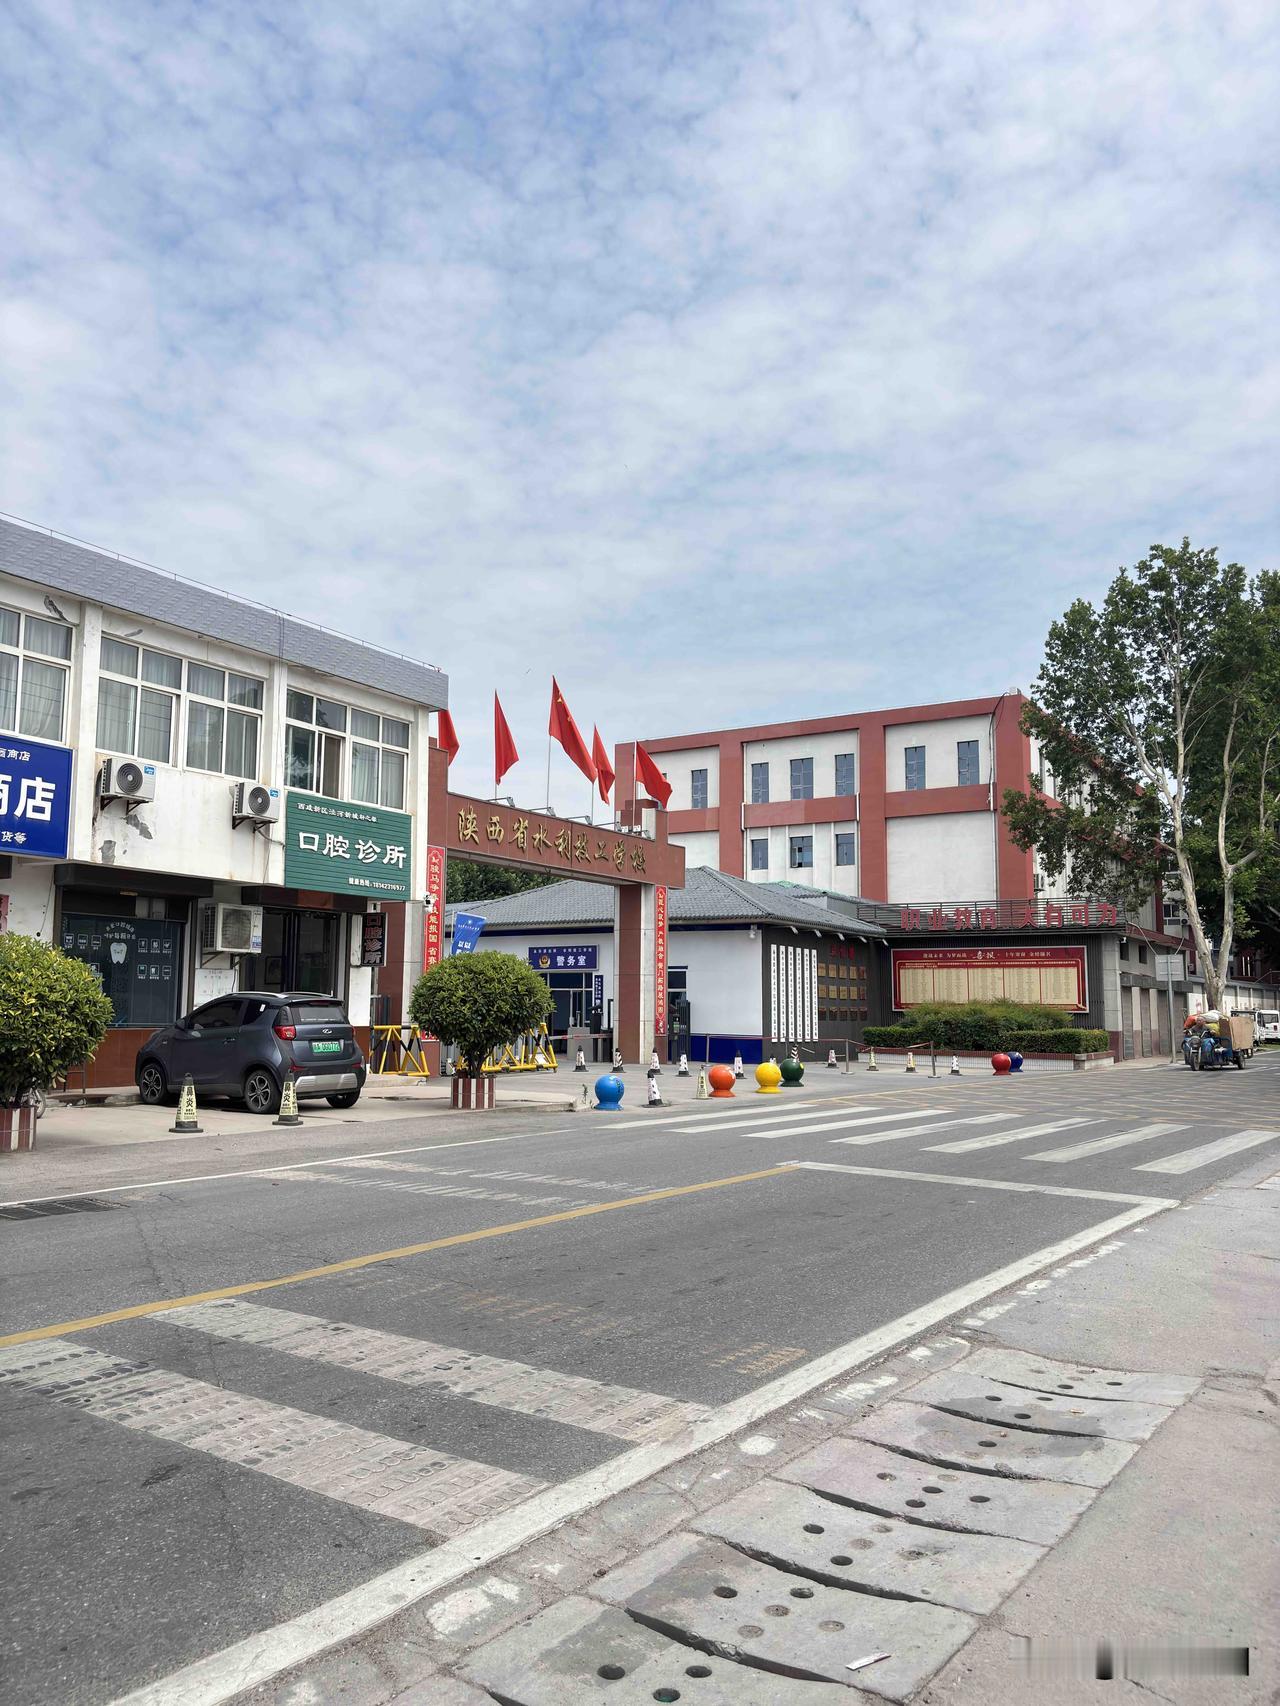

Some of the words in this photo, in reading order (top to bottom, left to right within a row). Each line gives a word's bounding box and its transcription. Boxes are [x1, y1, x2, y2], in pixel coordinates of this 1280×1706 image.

[299, 832, 407, 869] 口腔诊所
[458, 805, 646, 874] 陕西省水利技工学校
[900, 907, 998, 931] 职业教育
[1019, 902, 1118, 928] 大有可为
[364, 914, 383, 964] 口腔诊所
[557, 955, 586, 966] 警务室
[186, 1087, 194, 1107] 鼻炎
